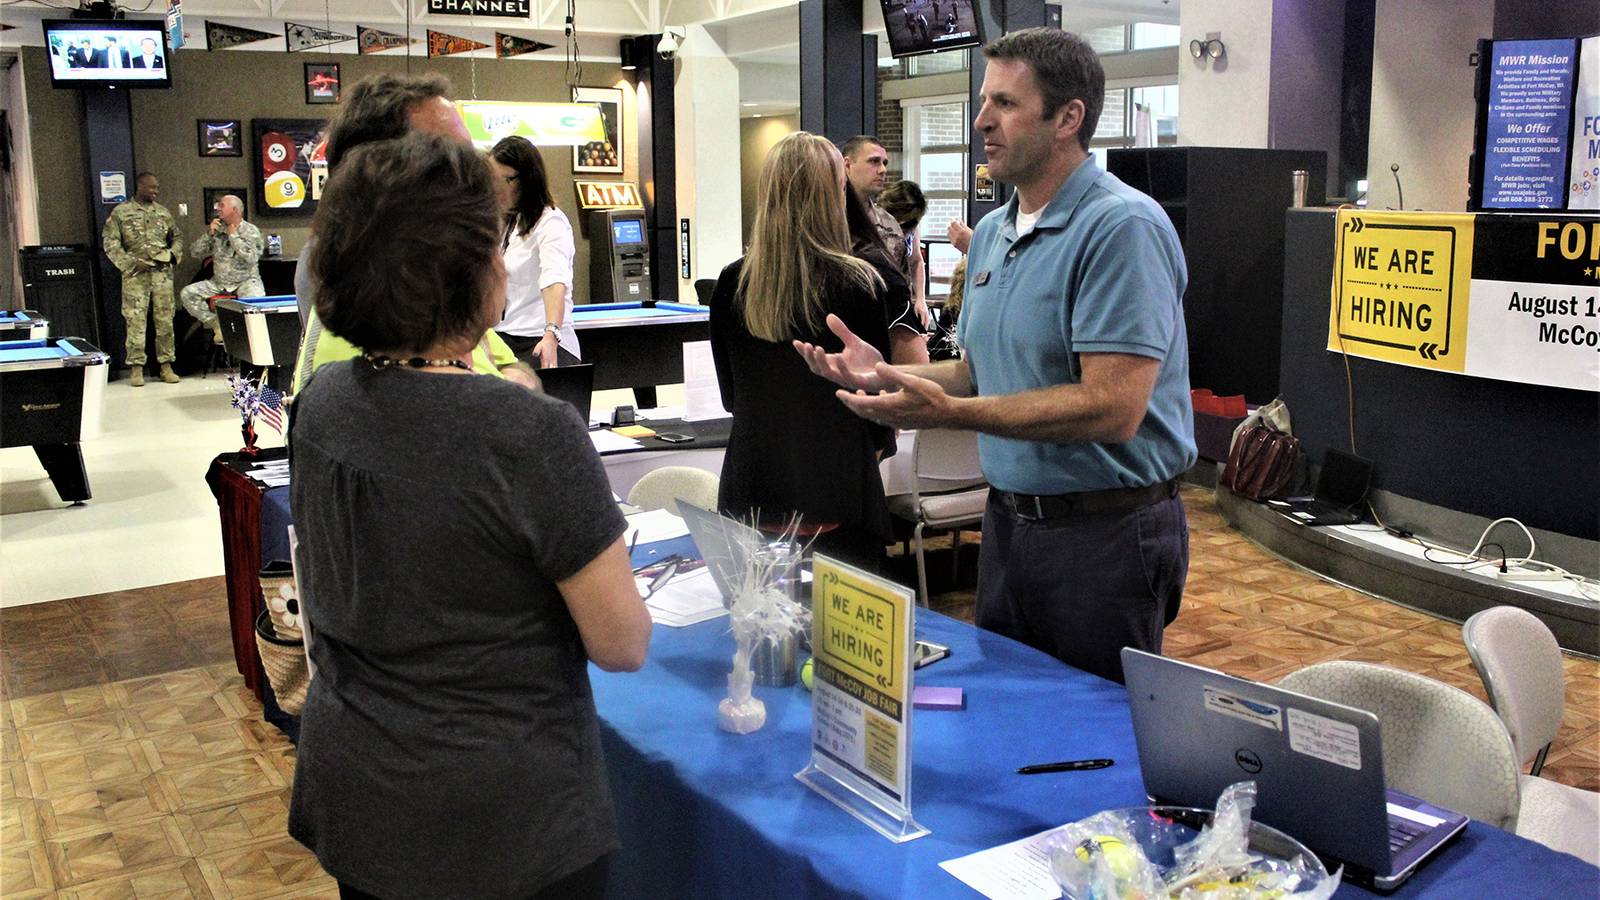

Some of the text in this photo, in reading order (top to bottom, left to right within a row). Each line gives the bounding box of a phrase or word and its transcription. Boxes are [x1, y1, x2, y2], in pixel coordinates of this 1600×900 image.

[432, 0, 528, 13] CHANNEL
[1499, 54, 1568, 65] MWR Mission
[1507, 123, 1552, 133] We Offer
[587, 184, 636, 206] ATM
[45, 268, 75, 276] TRASH
[1354, 246, 1435, 276] WE ARE
[1351, 295, 1433, 332] HIRING
[1508, 291, 1600, 318] August 1
[1539, 322, 1600, 352] McCo
[832, 593, 884, 631] WE ARE
[831, 626, 883, 667] HIRING
[880, 694, 898, 717] FAIR
[1239, 755, 1259, 767] DELL
